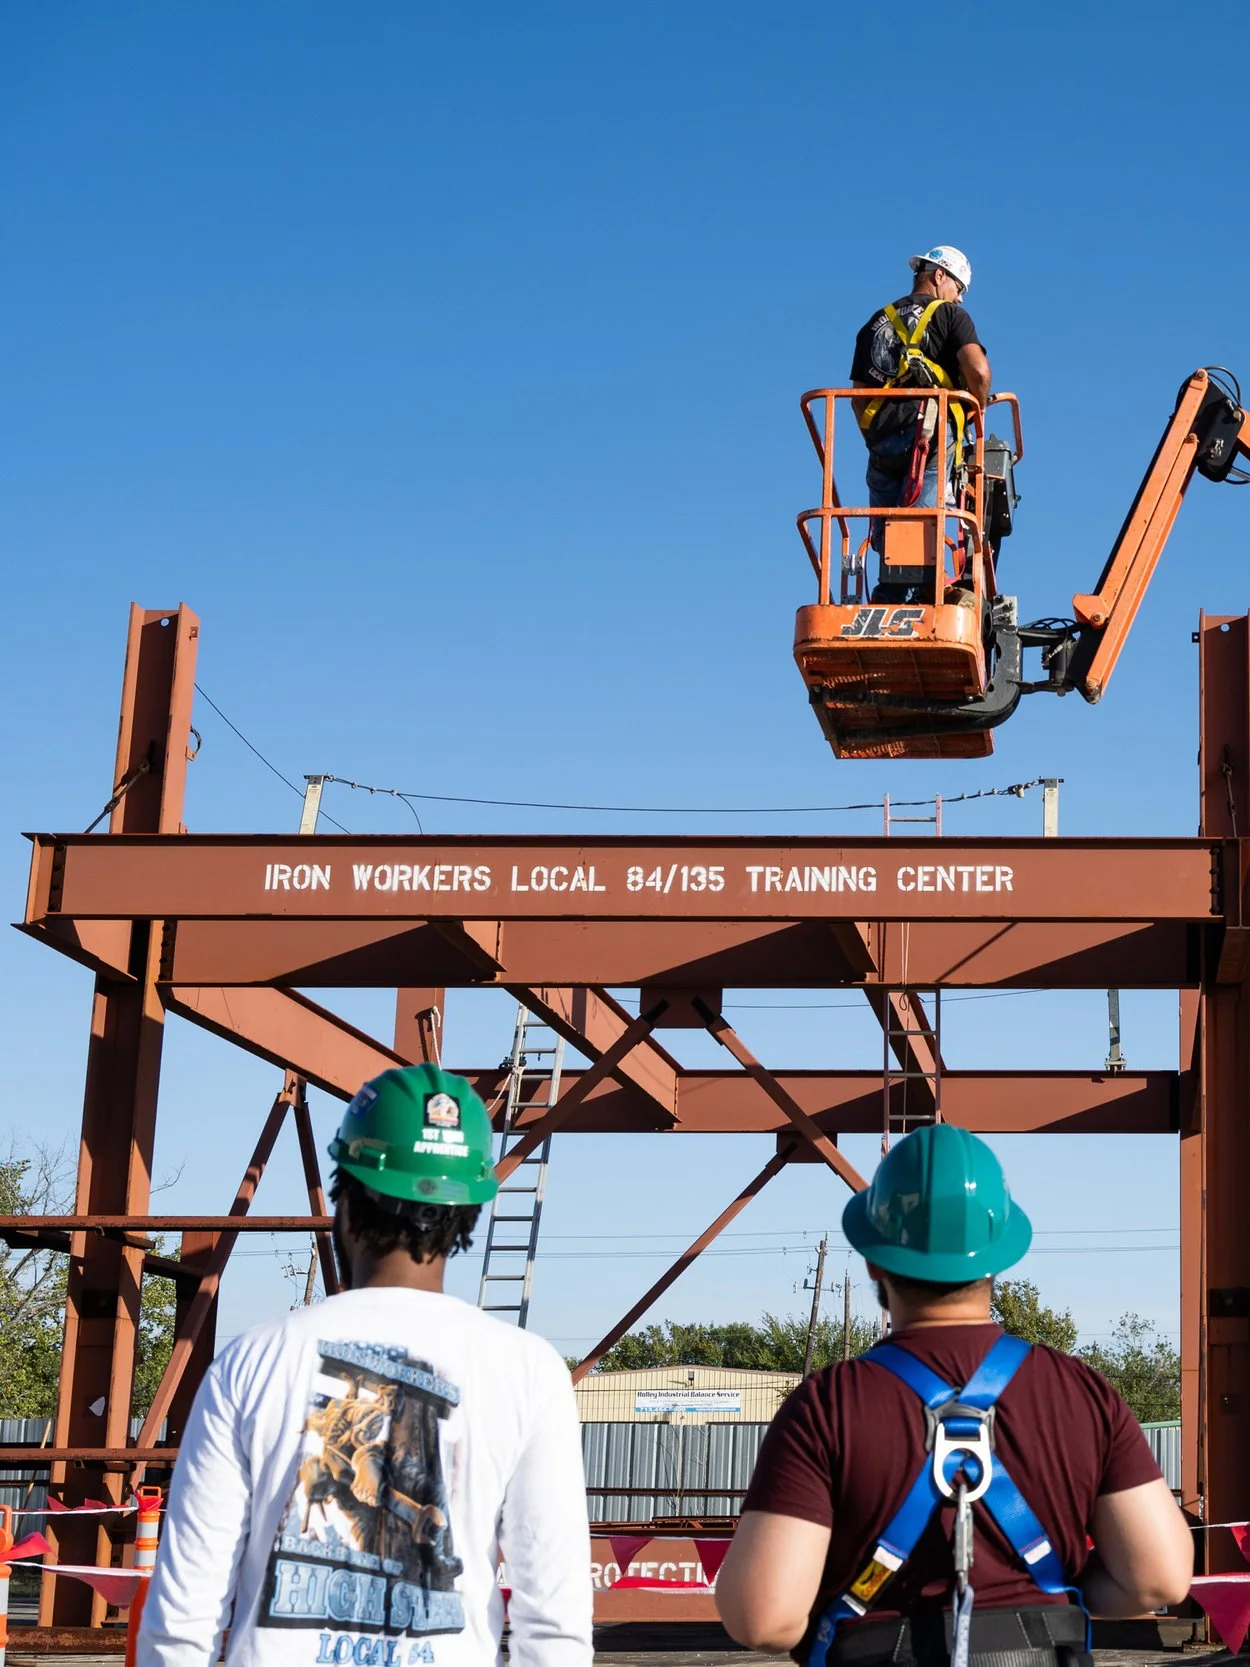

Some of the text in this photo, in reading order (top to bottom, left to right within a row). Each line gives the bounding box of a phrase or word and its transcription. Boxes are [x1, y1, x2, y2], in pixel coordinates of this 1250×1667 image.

[841, 607, 925, 637] JLG
[265, 864, 1014, 893] IRON WORKERS LOCAL 84/135 TRAINING CENTER
[590, 1562, 722, 1588] ROTECTI
[269, 1559, 466, 1631] HIGH STEEL
[316, 1633, 401, 1667] LOCAL
